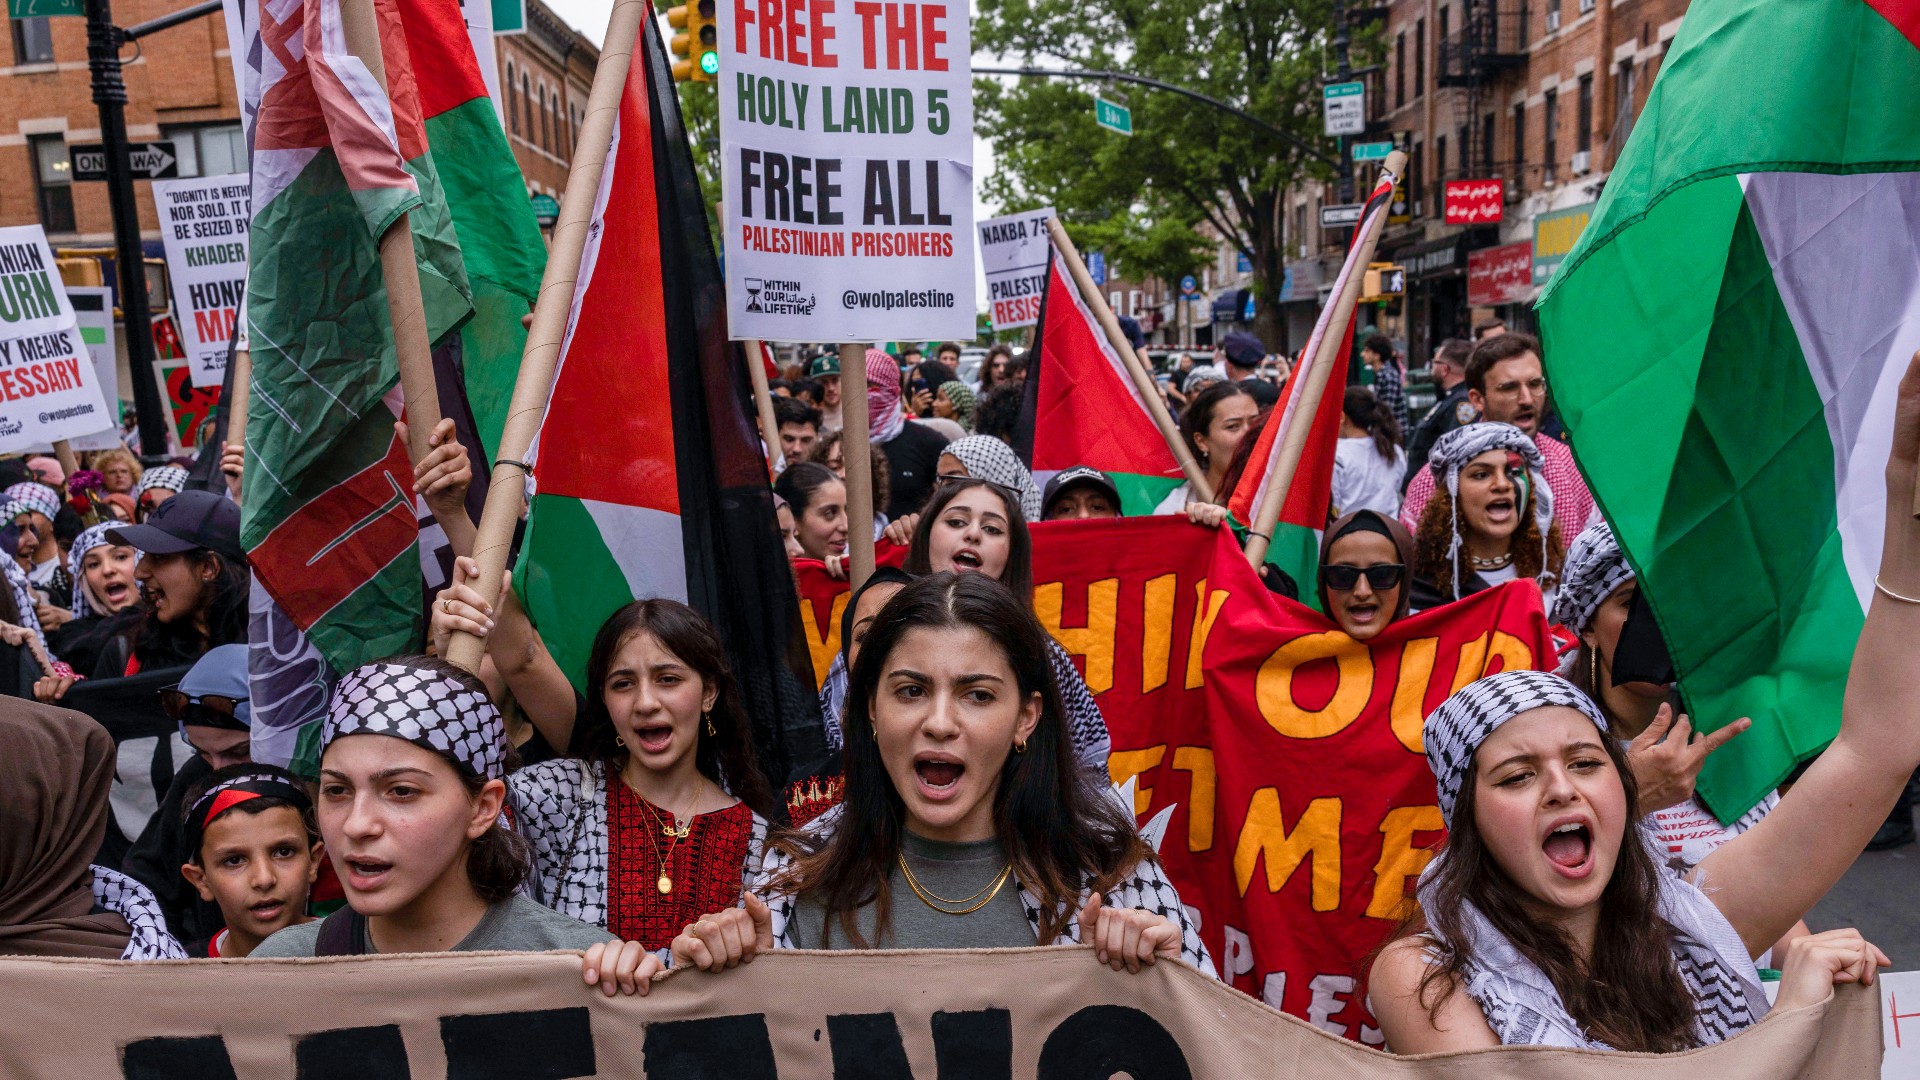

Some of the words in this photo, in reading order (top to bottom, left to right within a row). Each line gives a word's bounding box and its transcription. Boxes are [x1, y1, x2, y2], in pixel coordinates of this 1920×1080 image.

[733, 0, 839, 67] FREE
[854, 1, 949, 71] THE
[736, 72, 809, 131] HOLY
[821, 86, 914, 134] LAND
[927, 88, 950, 135] 5
[132, 152, 165, 168] WAY
[166, 189, 208, 204] "DIGNITY
[210, 188, 220, 200] IS
[741, 147, 844, 225] FREE
[863, 160, 952, 226] ALL
[169, 205, 195, 221] NOR
[197, 202, 229, 219] SOLD.
[231, 200, 241, 215] IT
[174, 224, 191, 240] BE
[193, 219, 233, 238] SEIZED
[982, 221, 1028, 245] NAKBA
[742, 225, 845, 257] PALESTINIAN
[851, 232, 953, 257] PRISONERS
[184, 242, 246, 267] KHADER
[763, 280, 801, 292] WITHIN
[764, 291, 785, 302] OUR
[764, 303, 812, 315] LIFETIME
[842, 288, 955, 311] @wolpalestine
[16, 332, 74, 363] MEANS
[38, 403, 95, 424] @wolpalestine
